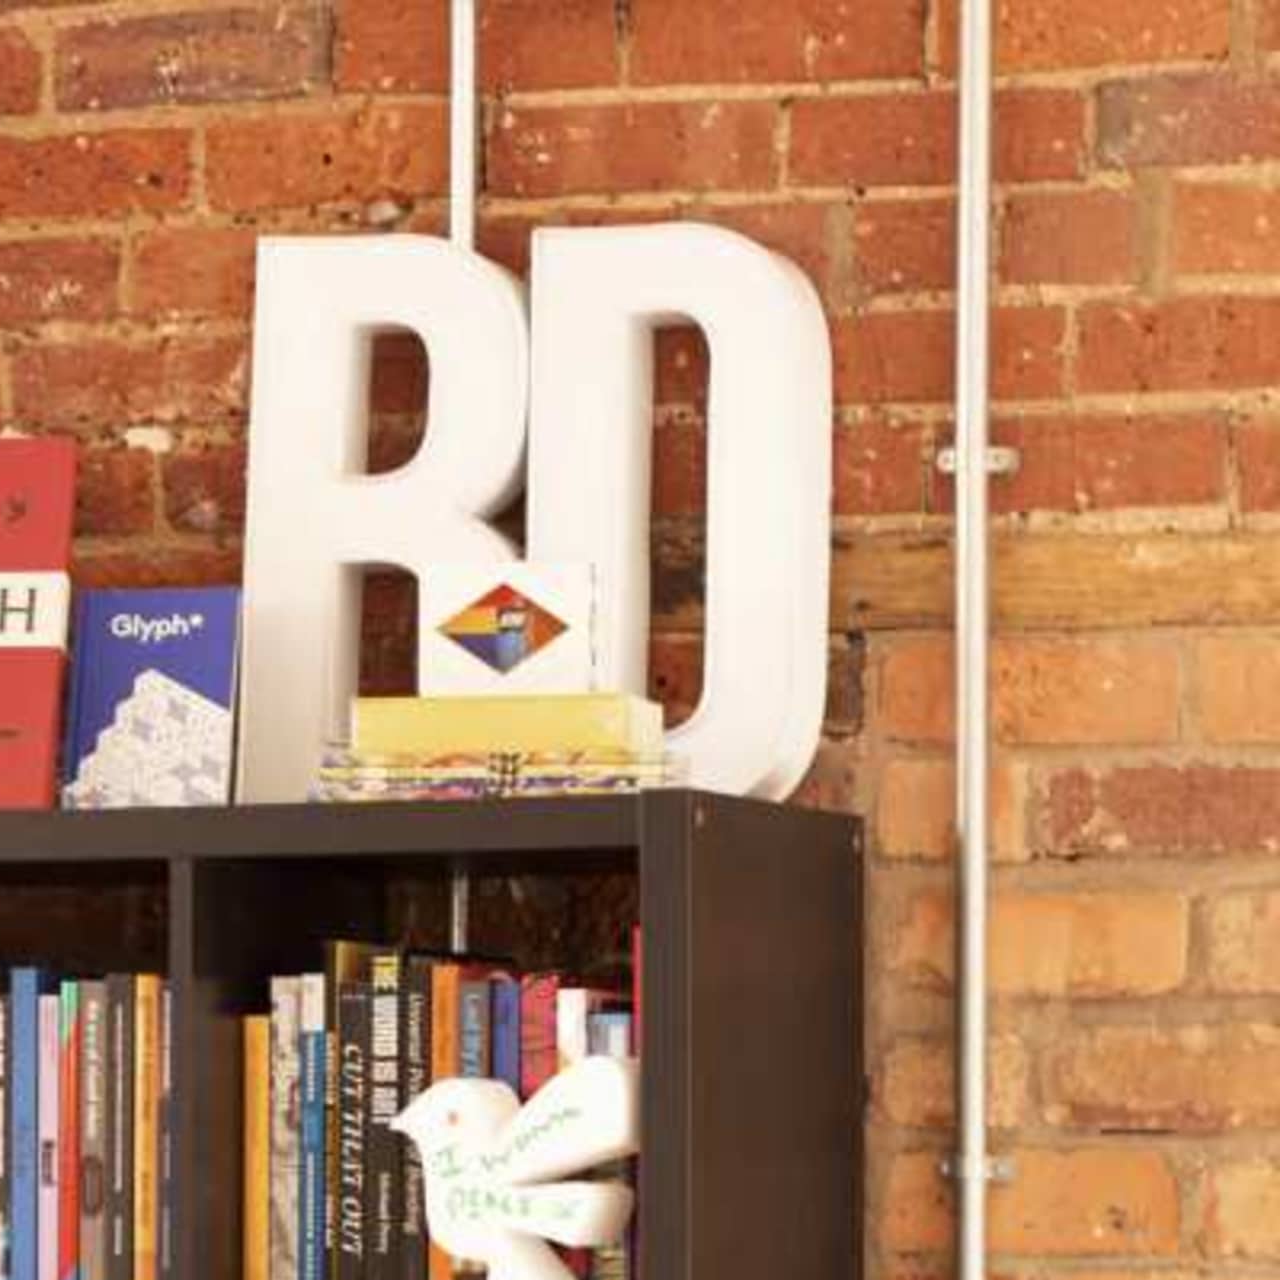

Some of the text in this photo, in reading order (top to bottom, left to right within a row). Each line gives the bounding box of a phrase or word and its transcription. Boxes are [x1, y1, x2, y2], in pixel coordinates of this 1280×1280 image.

[341, 1044, 364, 1258] CUT THAT OUT
